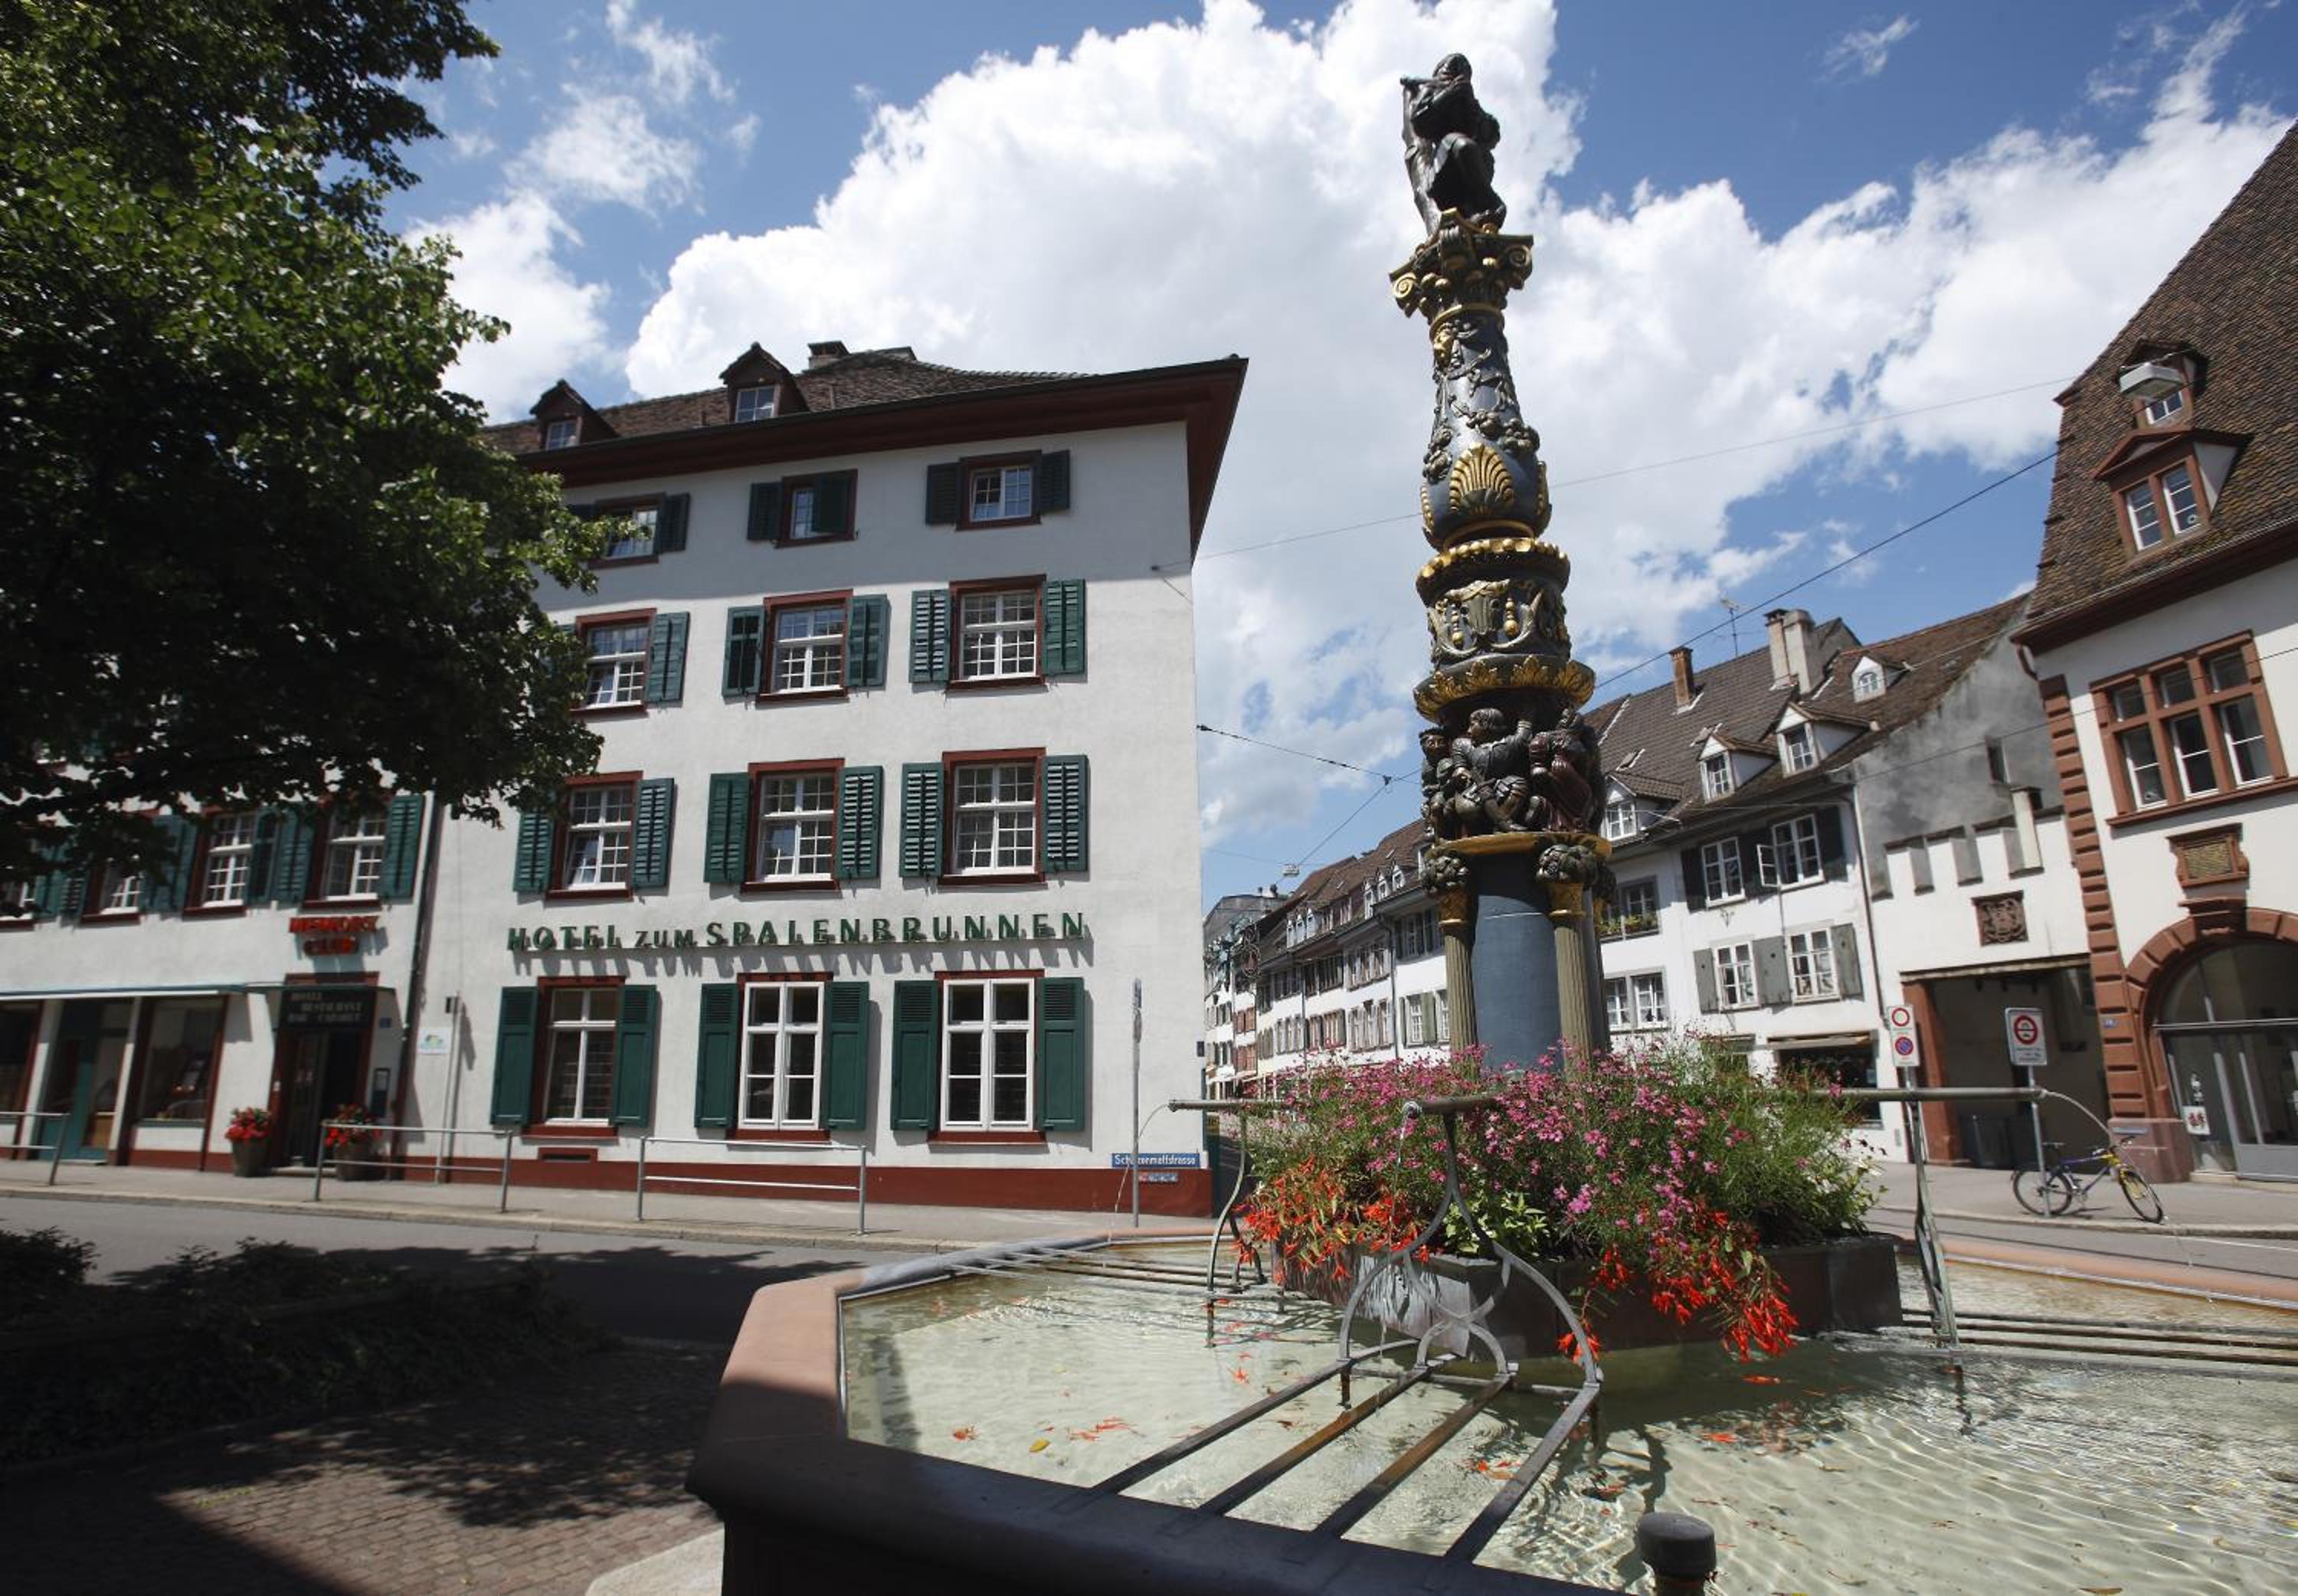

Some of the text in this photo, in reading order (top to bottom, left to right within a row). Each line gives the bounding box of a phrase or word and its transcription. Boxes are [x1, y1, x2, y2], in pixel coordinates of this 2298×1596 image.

[507, 912, 1084, 951] HOTEL ZUM SPALENBRUNNEN
